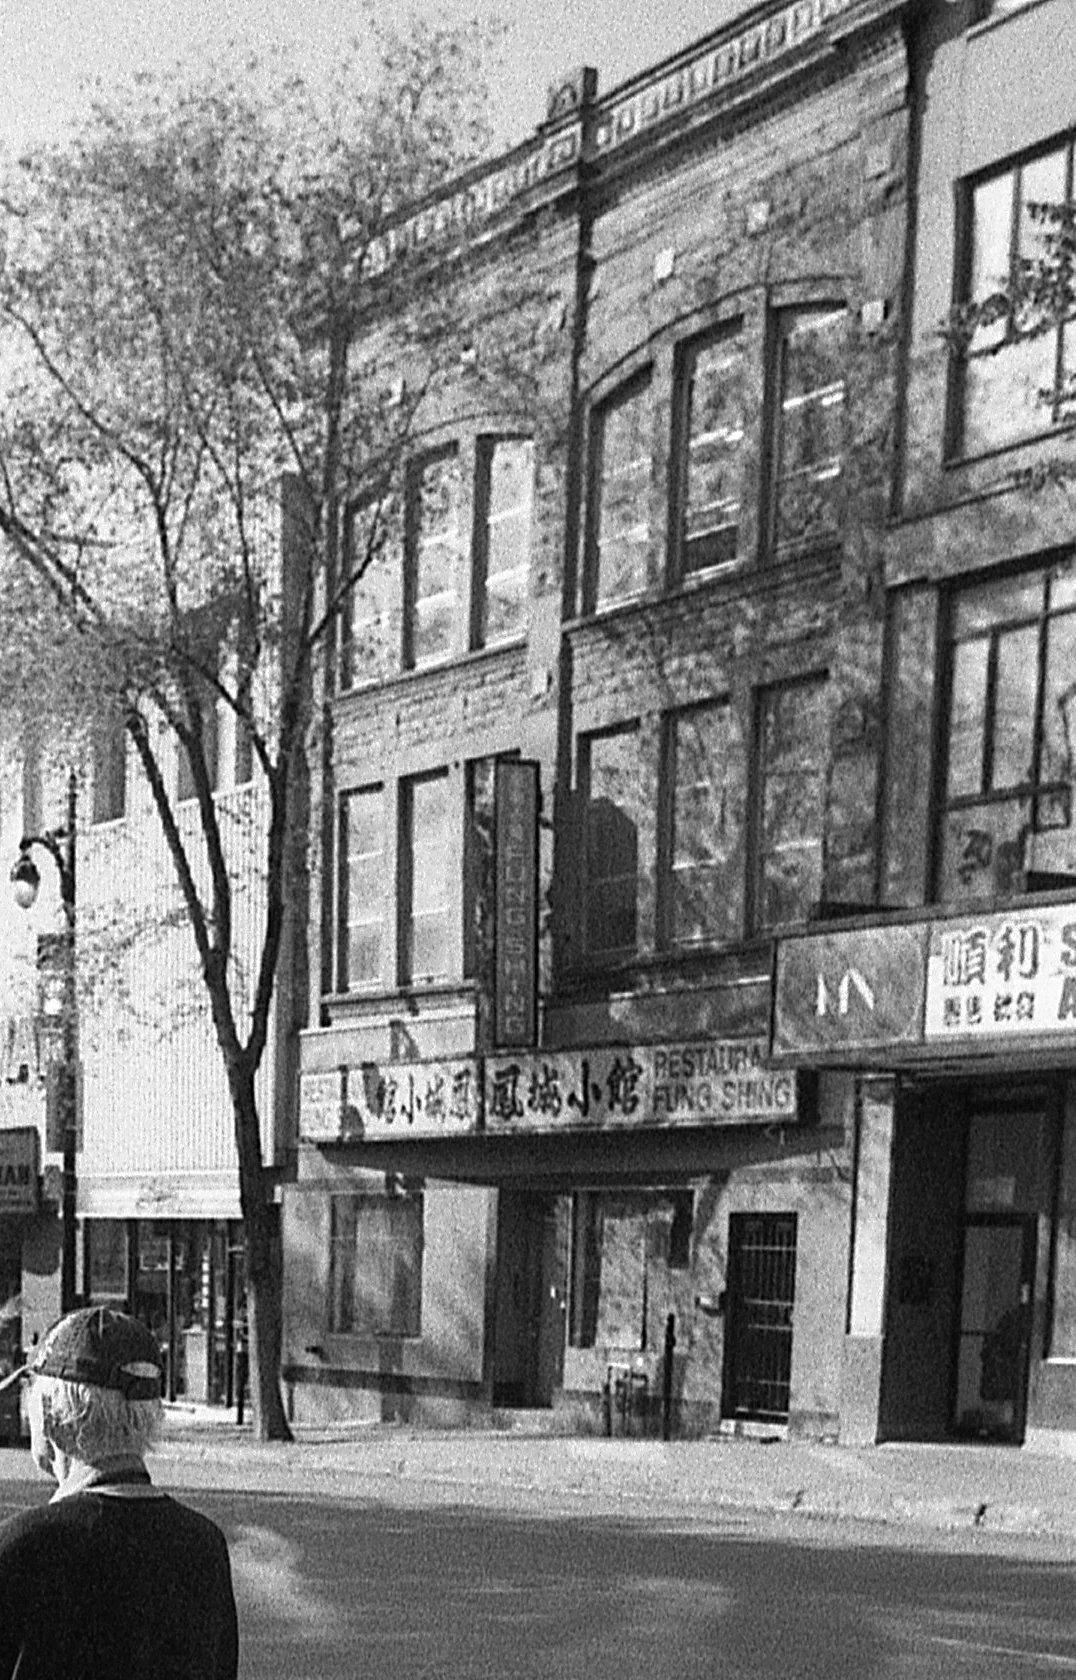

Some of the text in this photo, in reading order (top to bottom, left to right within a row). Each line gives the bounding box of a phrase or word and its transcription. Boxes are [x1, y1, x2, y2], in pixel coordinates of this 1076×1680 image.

[942, 928, 1038, 986] 順利
[654, 1045, 766, 1078] RESTAURA
[653, 1077, 791, 1112] FUNG SHING
